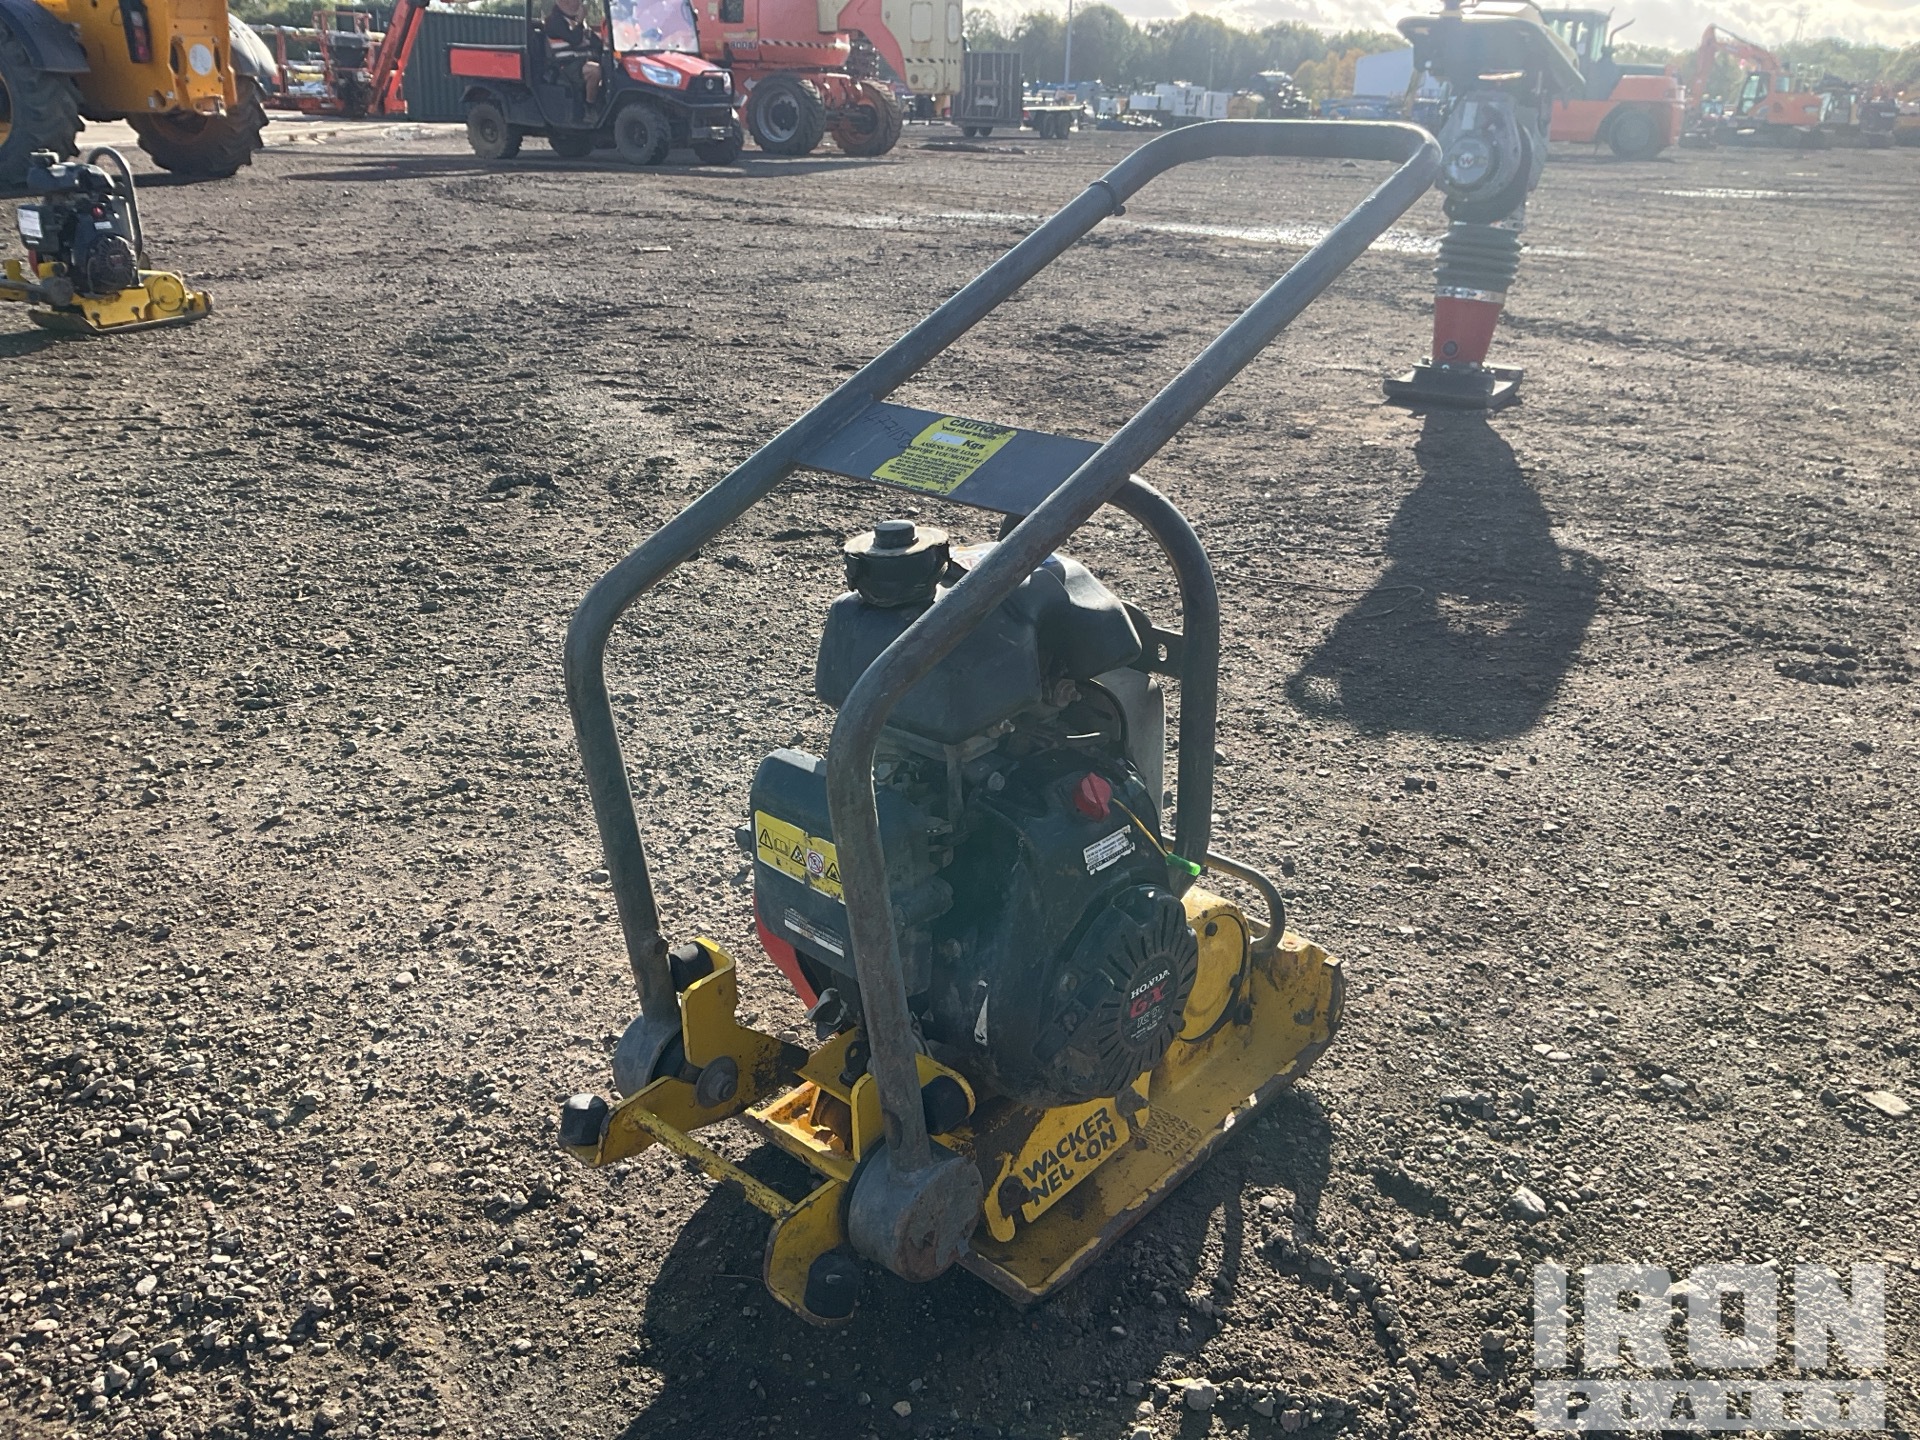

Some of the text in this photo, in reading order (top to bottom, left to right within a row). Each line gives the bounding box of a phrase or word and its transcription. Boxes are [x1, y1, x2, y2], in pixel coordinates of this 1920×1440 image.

[960, 449, 979, 457] LOAD
[962, 440, 986, 450] Kgs
[1131, 969, 1171, 999] HONDA
[1022, 1107, 1112, 1183] WACKER
